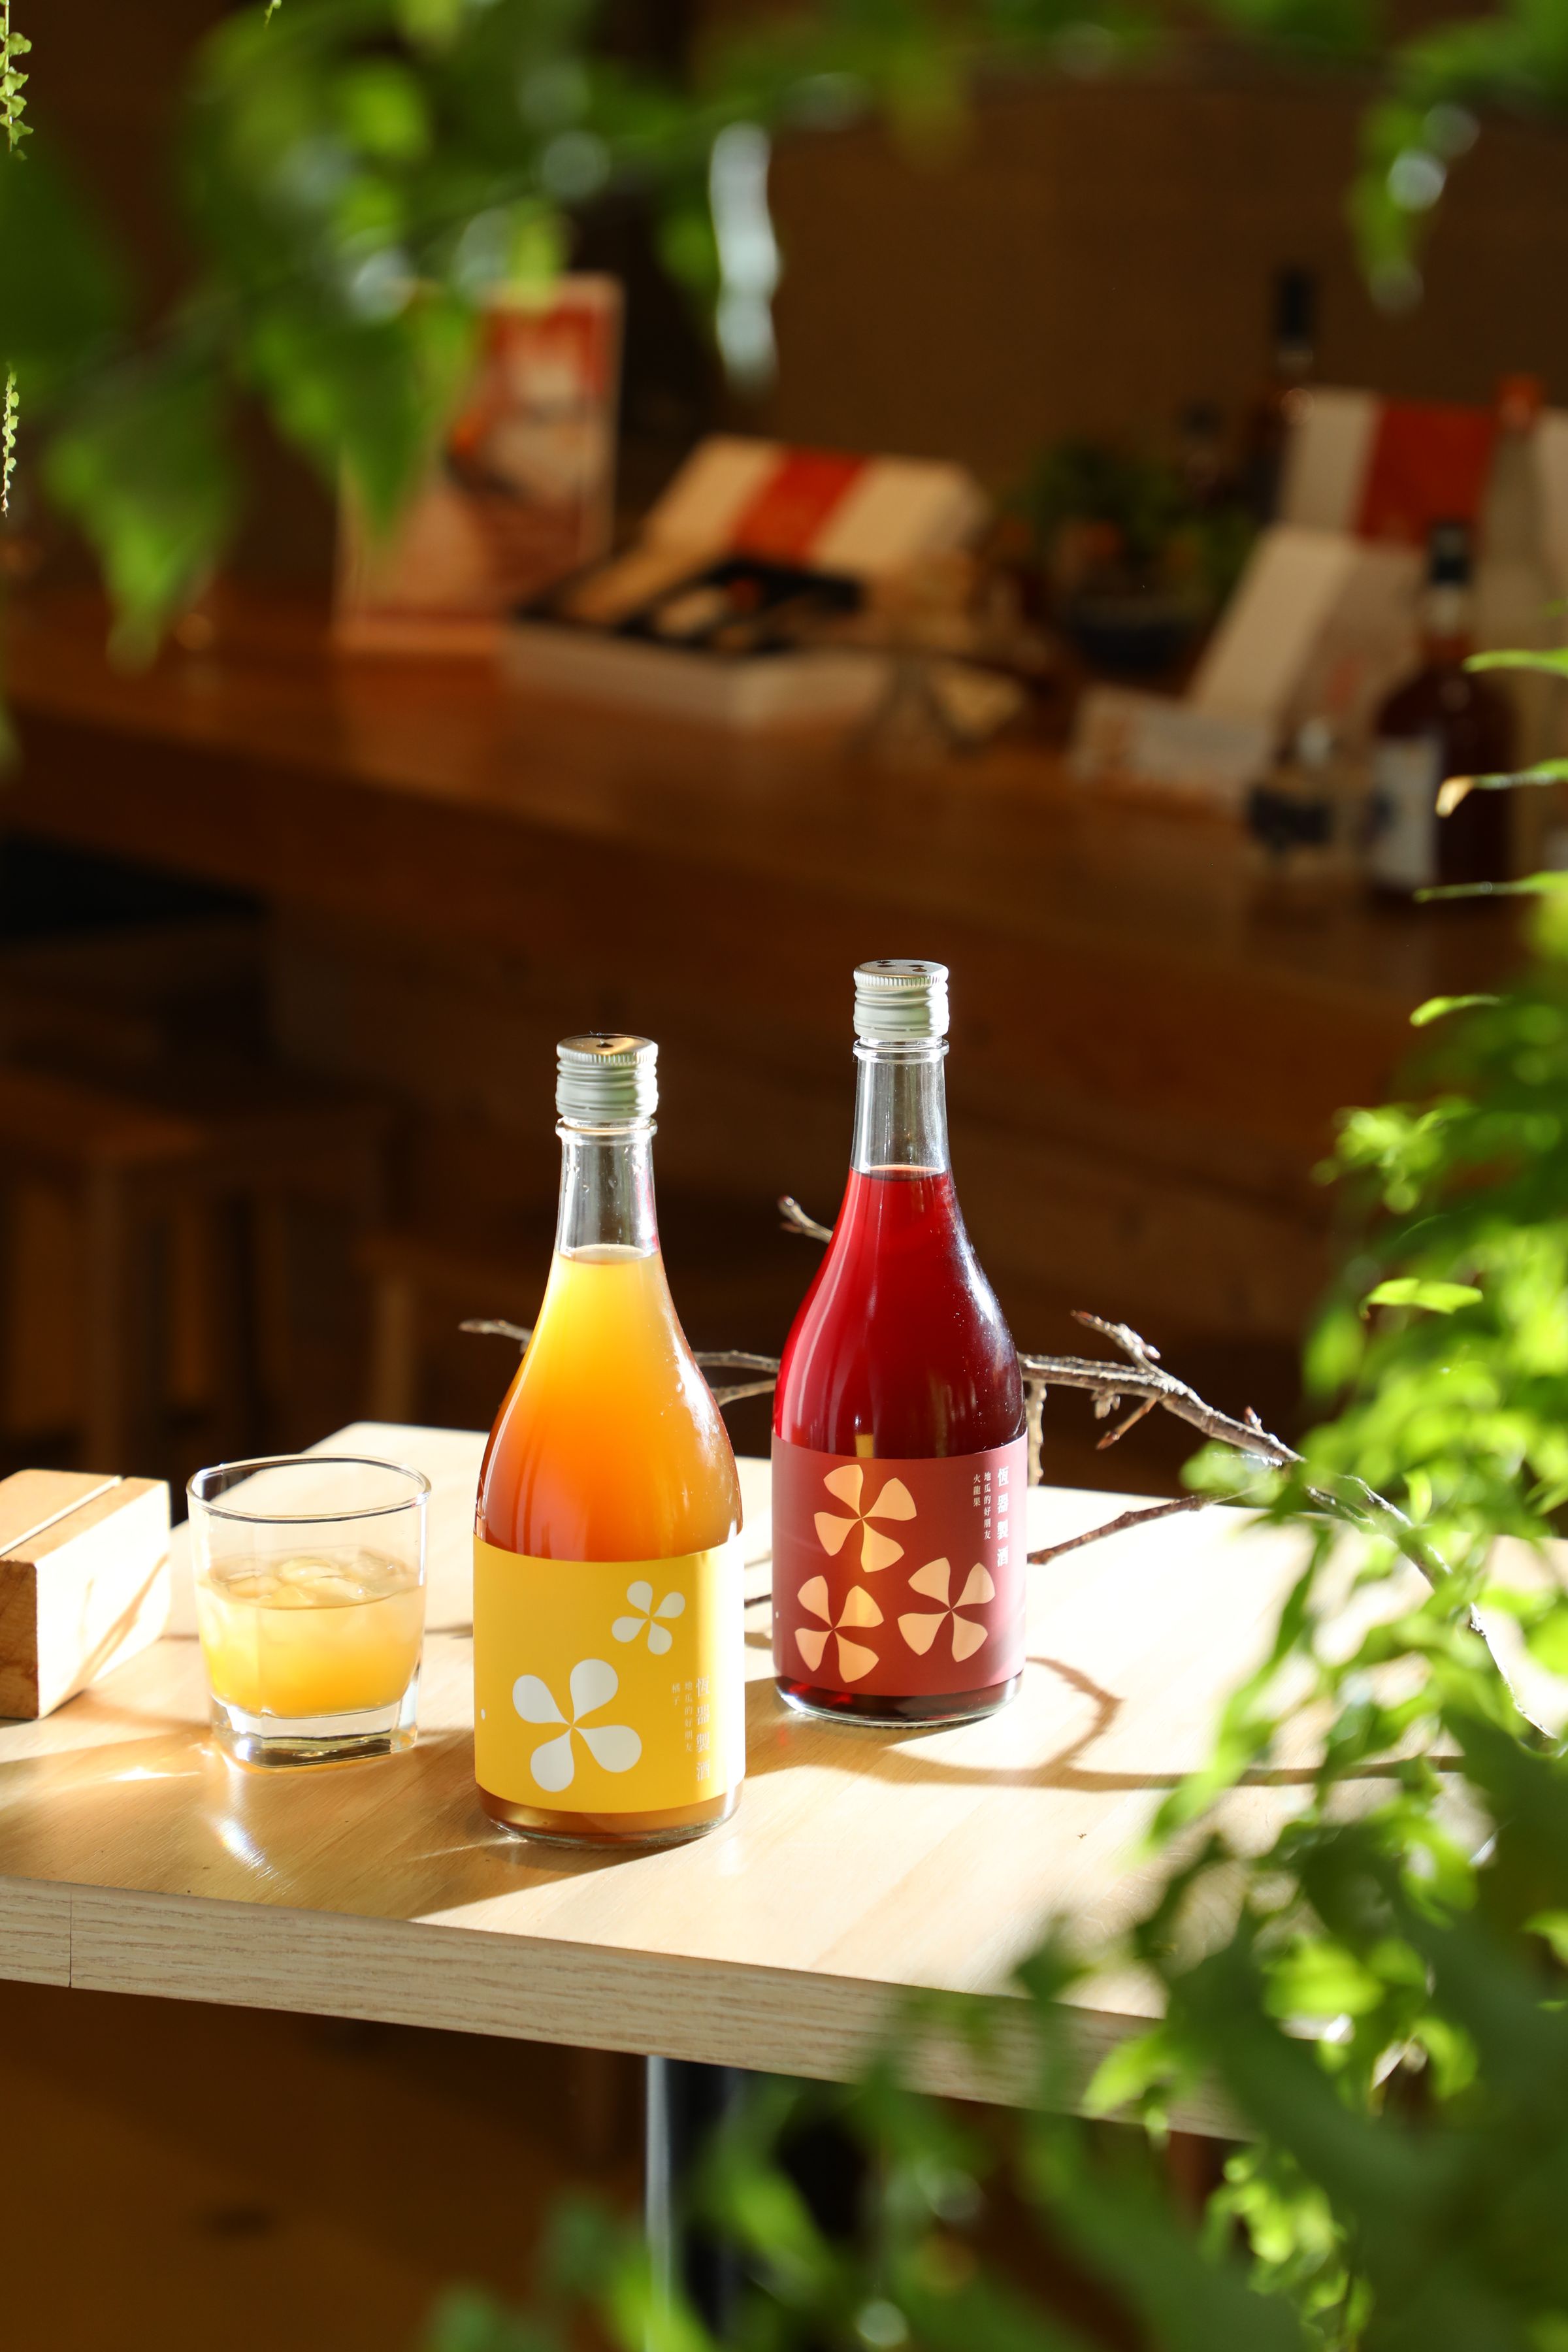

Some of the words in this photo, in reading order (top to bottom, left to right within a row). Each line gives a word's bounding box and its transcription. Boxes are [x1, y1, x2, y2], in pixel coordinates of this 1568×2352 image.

[973, 1474, 981, 1507] 火龍果
[983, 1471, 992, 1539] 地瓜的好朋友
[997, 1467, 1009, 1567] 恆器製酒
[696, 1676, 710, 1781] 恆器製酒
